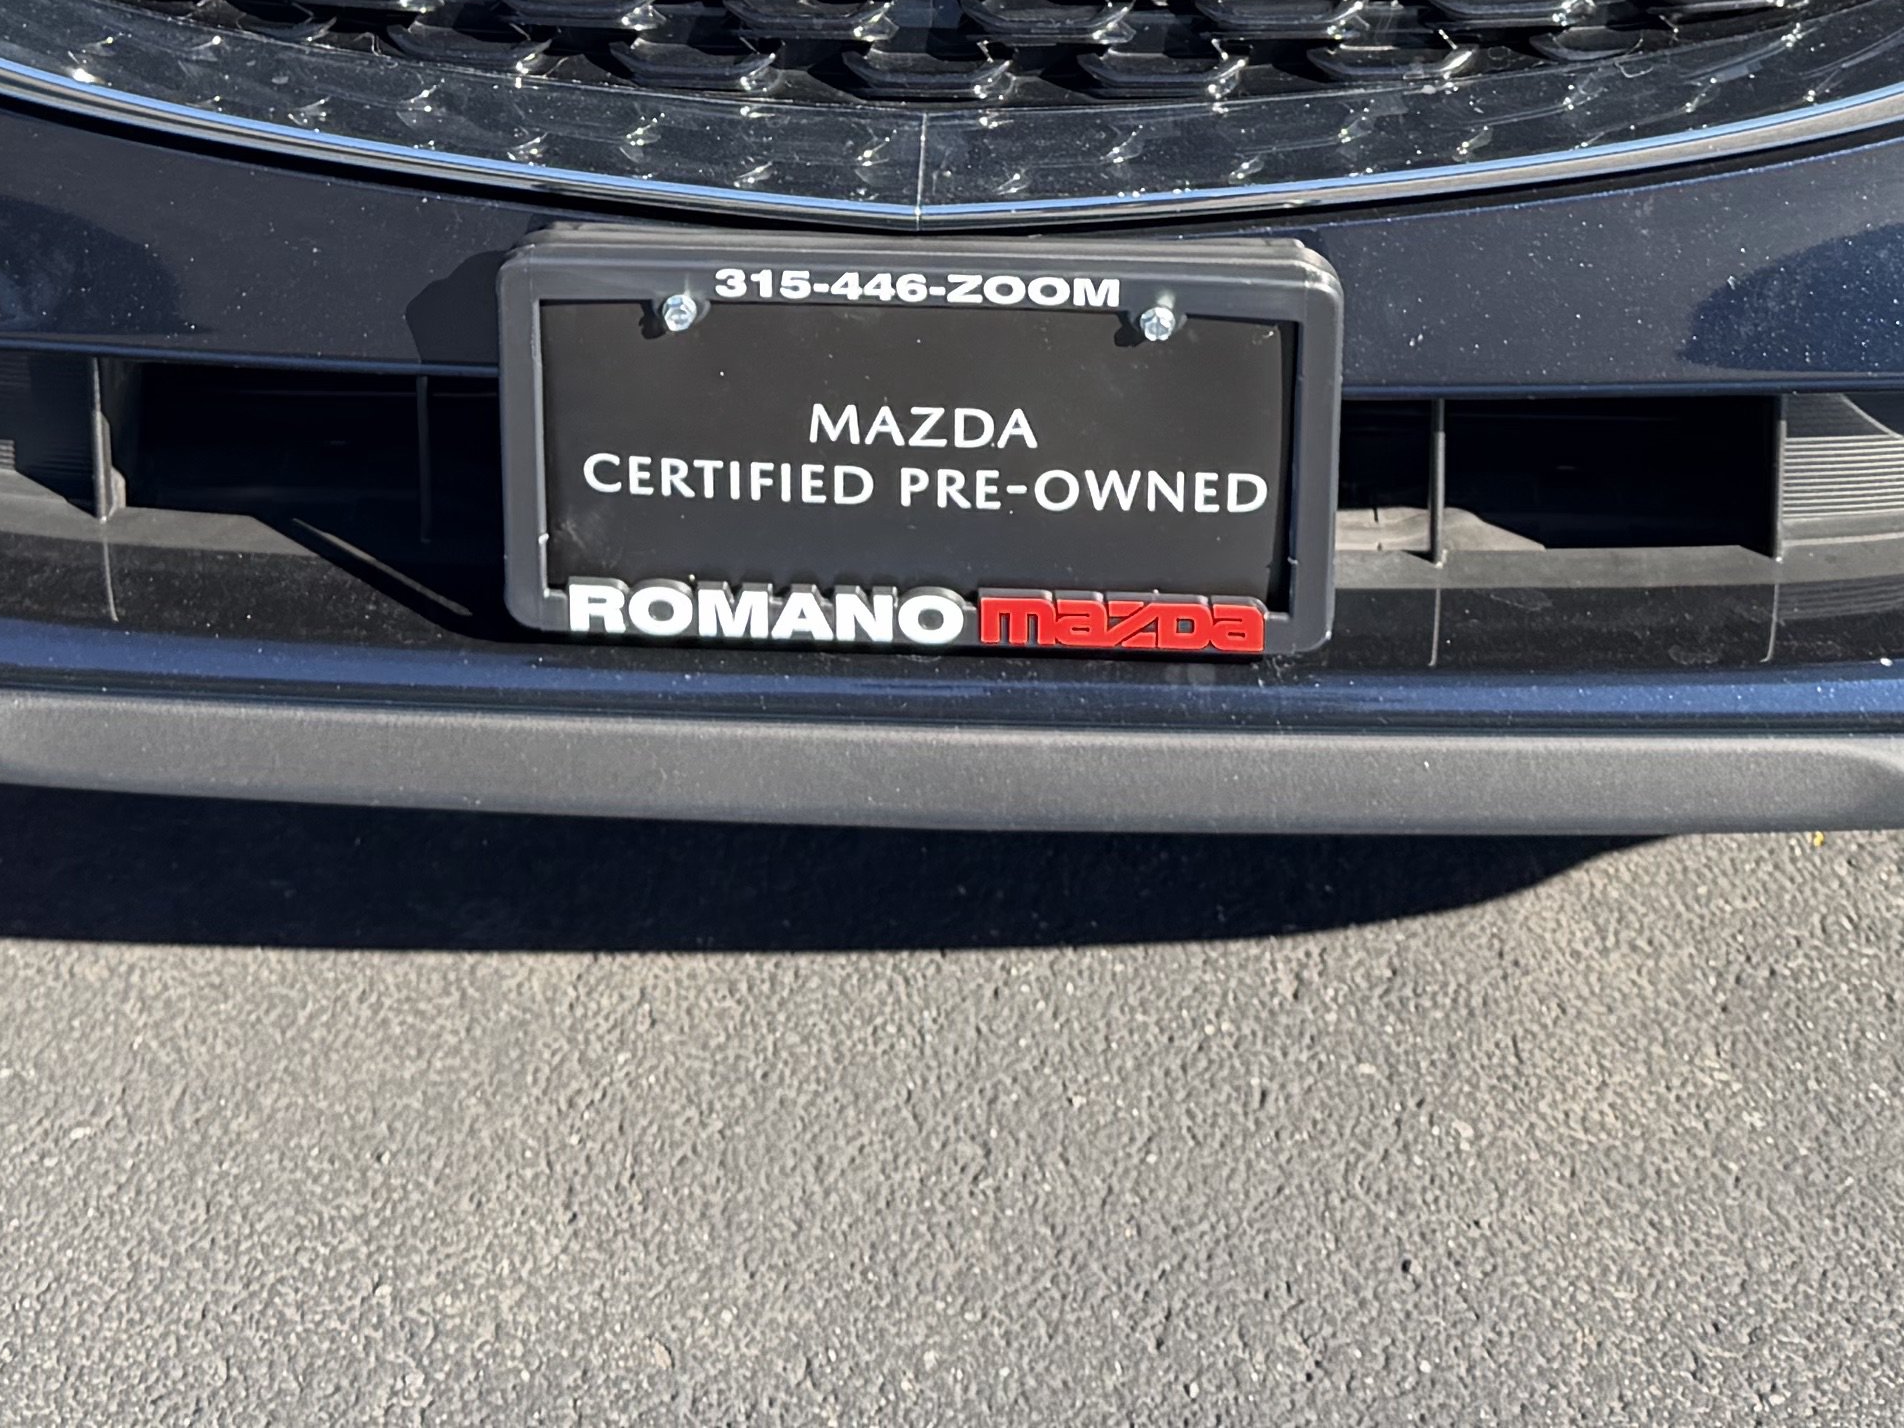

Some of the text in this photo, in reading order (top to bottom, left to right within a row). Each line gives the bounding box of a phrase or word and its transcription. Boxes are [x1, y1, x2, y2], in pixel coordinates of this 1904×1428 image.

[714, 268, 1121, 308] 315-446-ZOOM
[809, 403, 1038, 449] MAZDA
[583, 452, 1268, 514] CERTIFIED PRE-OWNED
[568, 581, 965, 645] ROMANO
